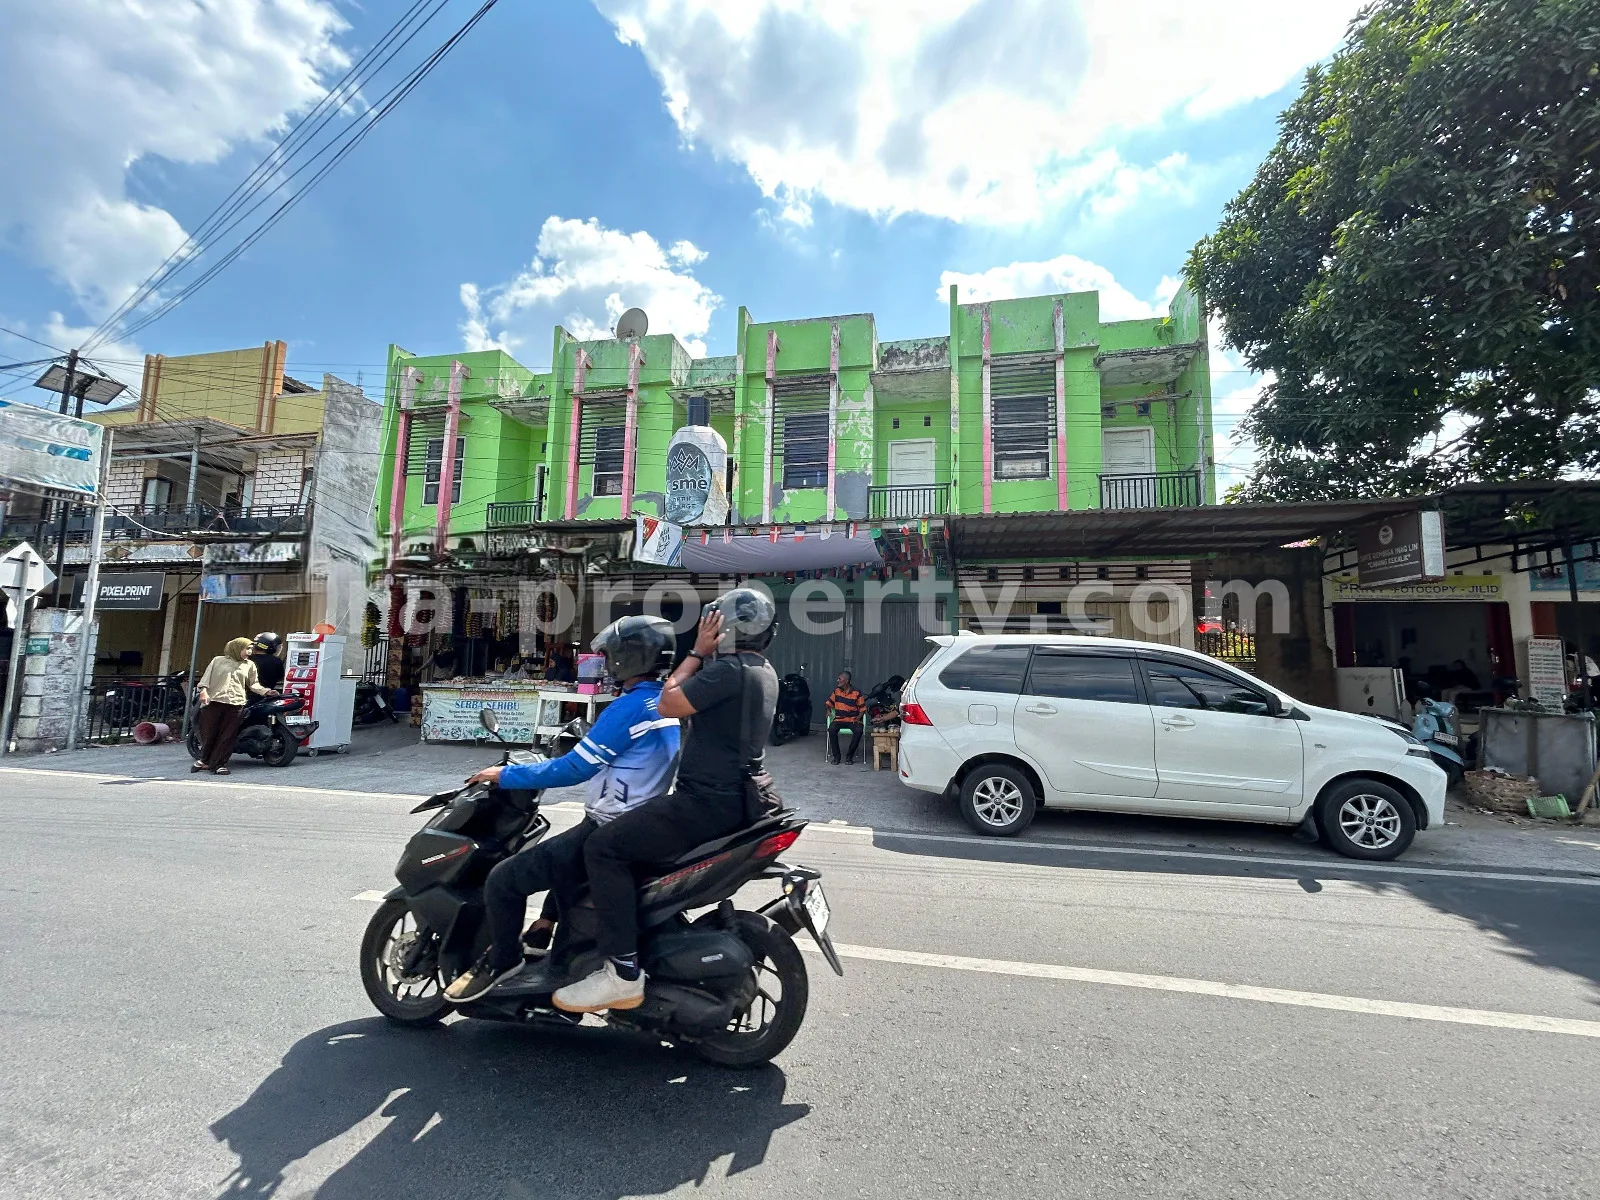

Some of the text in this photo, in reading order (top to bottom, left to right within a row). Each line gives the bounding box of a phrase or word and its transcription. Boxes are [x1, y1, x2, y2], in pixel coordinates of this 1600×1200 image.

[100, 586, 152, 596] PIXELPRINT
[1468, 585, 1499, 593] JILID
[486, 701, 520, 710] SERIBU
